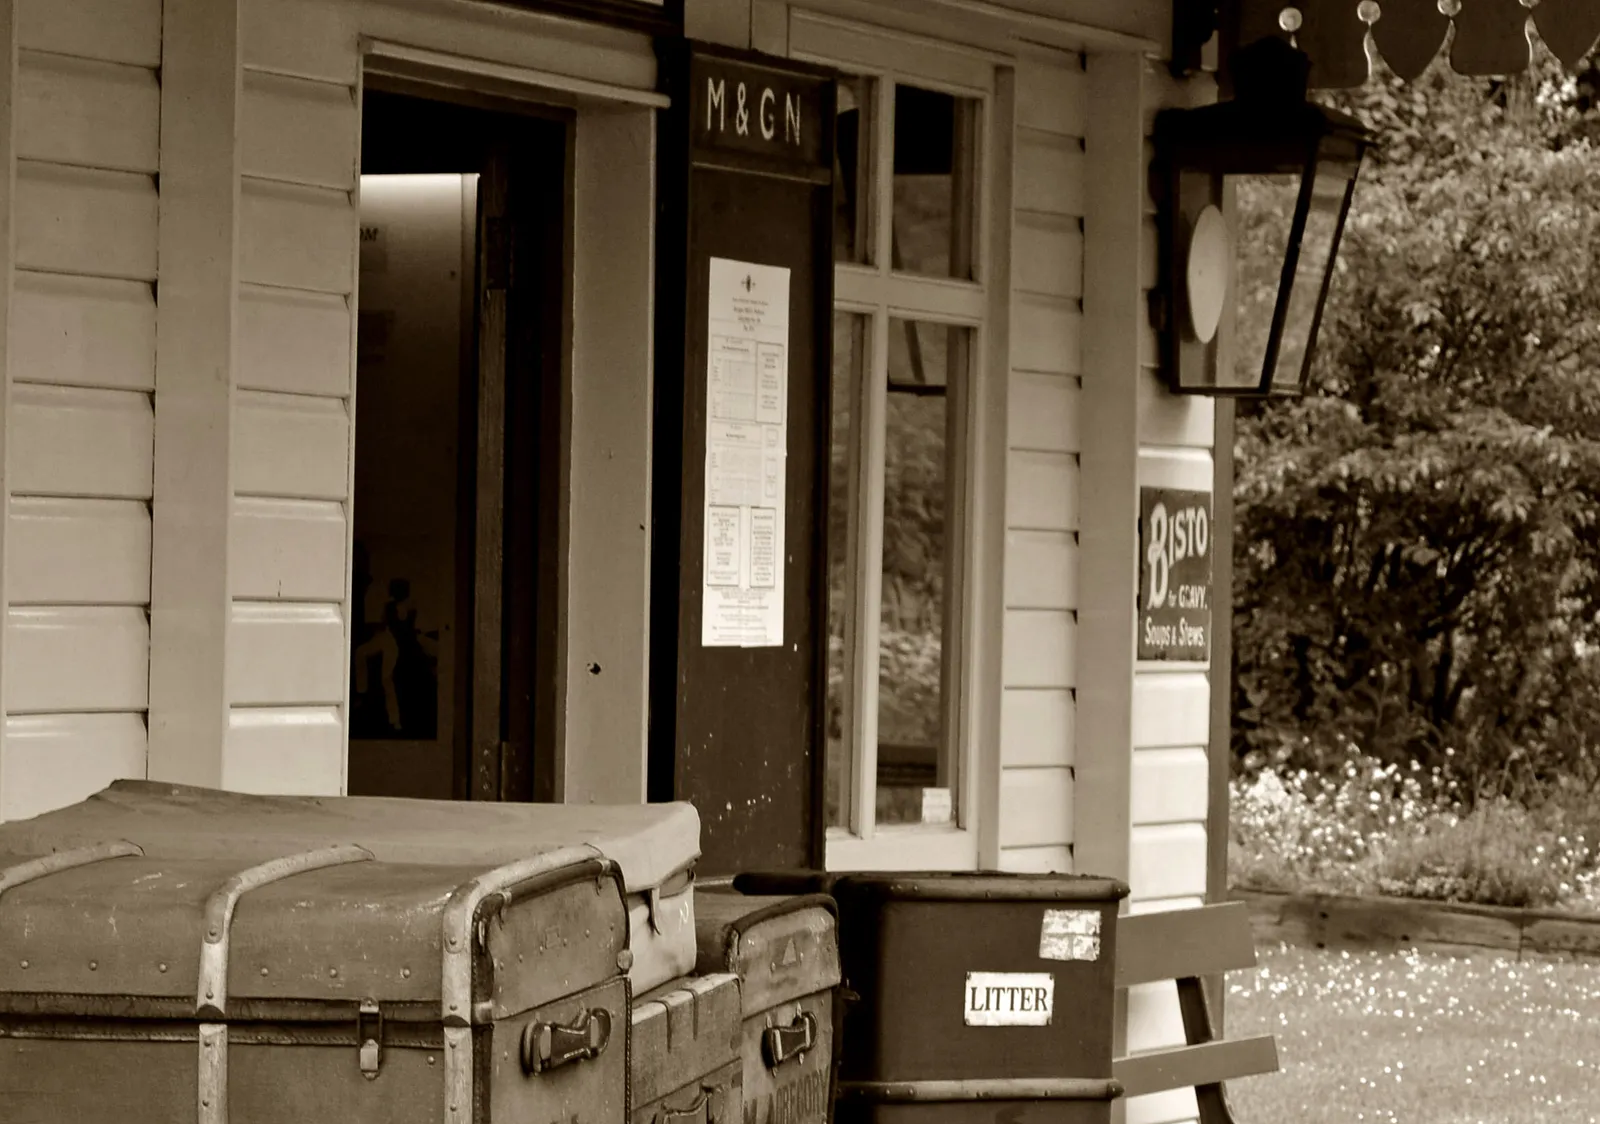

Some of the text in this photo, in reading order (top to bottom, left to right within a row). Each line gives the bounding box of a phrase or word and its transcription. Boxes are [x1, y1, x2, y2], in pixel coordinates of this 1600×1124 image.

[1147, 502, 1208, 610] BISTO
[1144, 616, 1171, 650] Soups
[970, 986, 1048, 1011] LITTER
